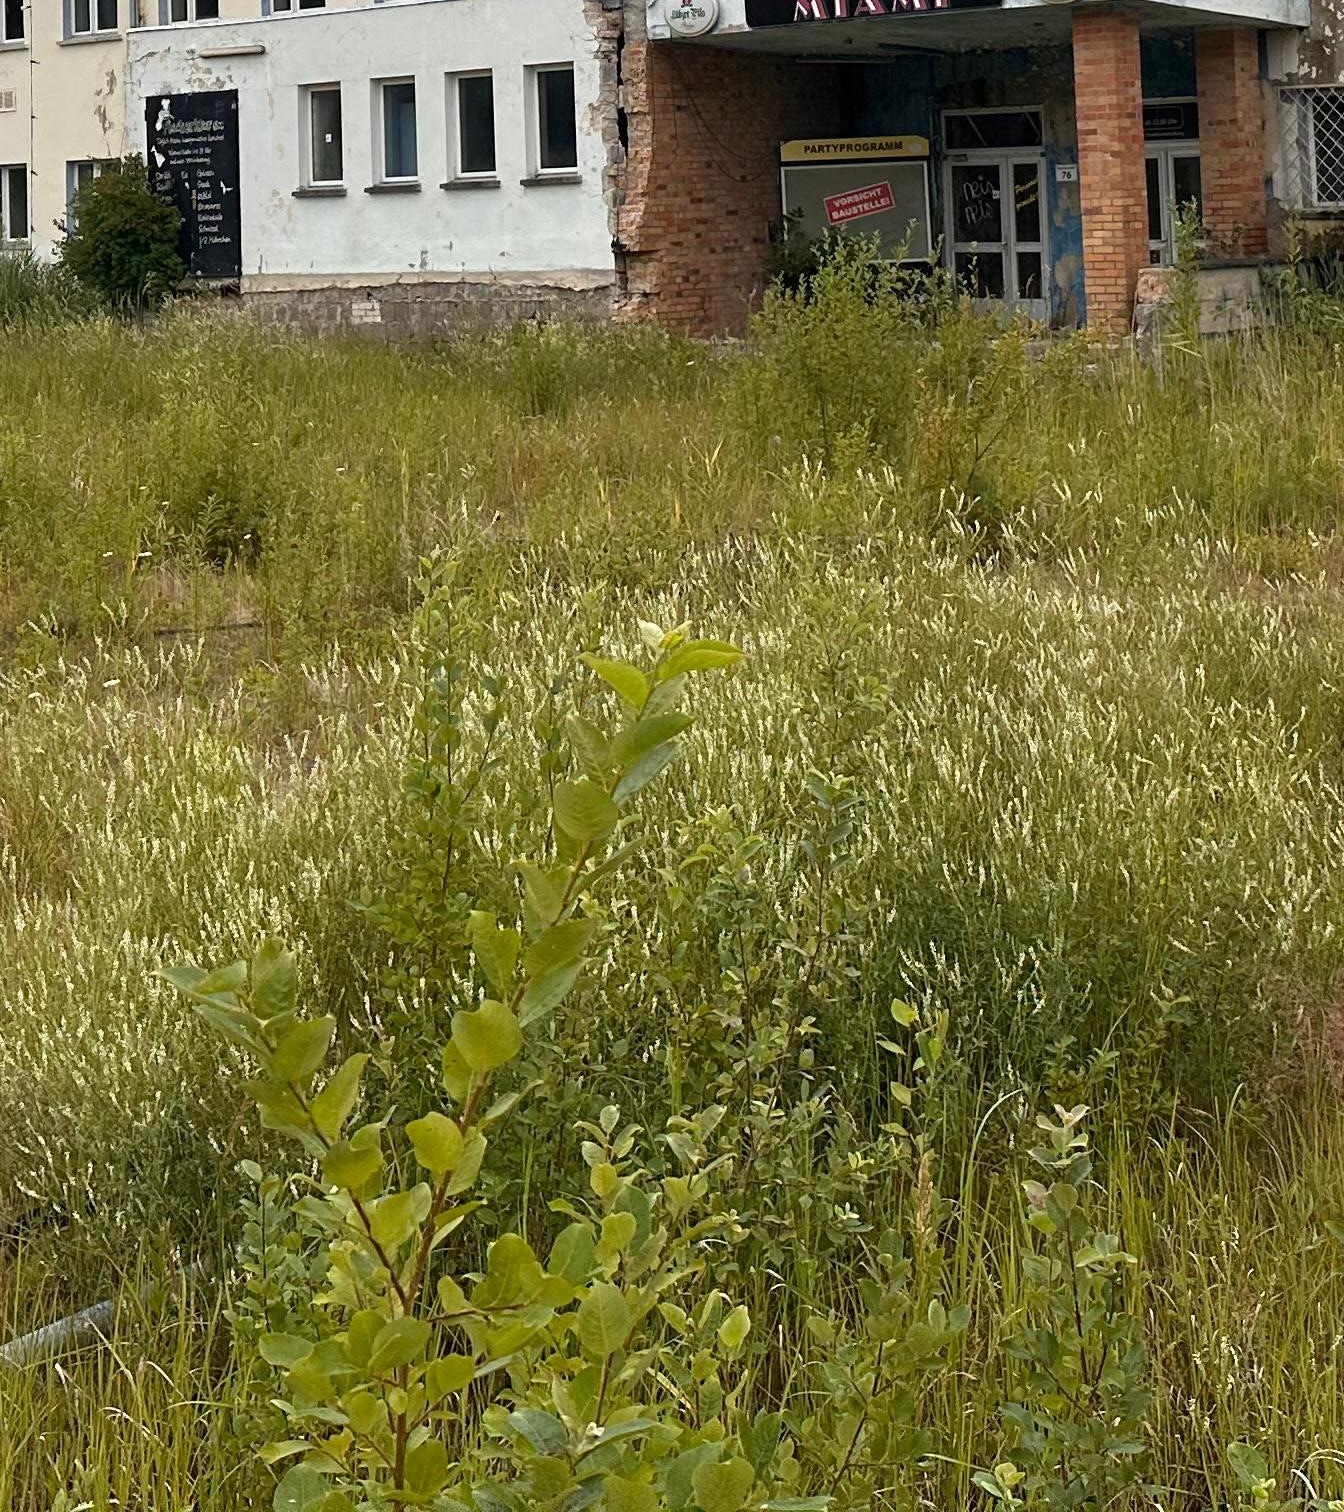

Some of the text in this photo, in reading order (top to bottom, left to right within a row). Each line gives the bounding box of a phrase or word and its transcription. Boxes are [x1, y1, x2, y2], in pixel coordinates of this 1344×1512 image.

[804, 141, 904, 154] PARTYPROGRAMM
[1061, 170, 1072, 179] 76
[832, 187, 883, 208] VORSICHT
[831, 197, 891, 220] BAUSTELLE!
